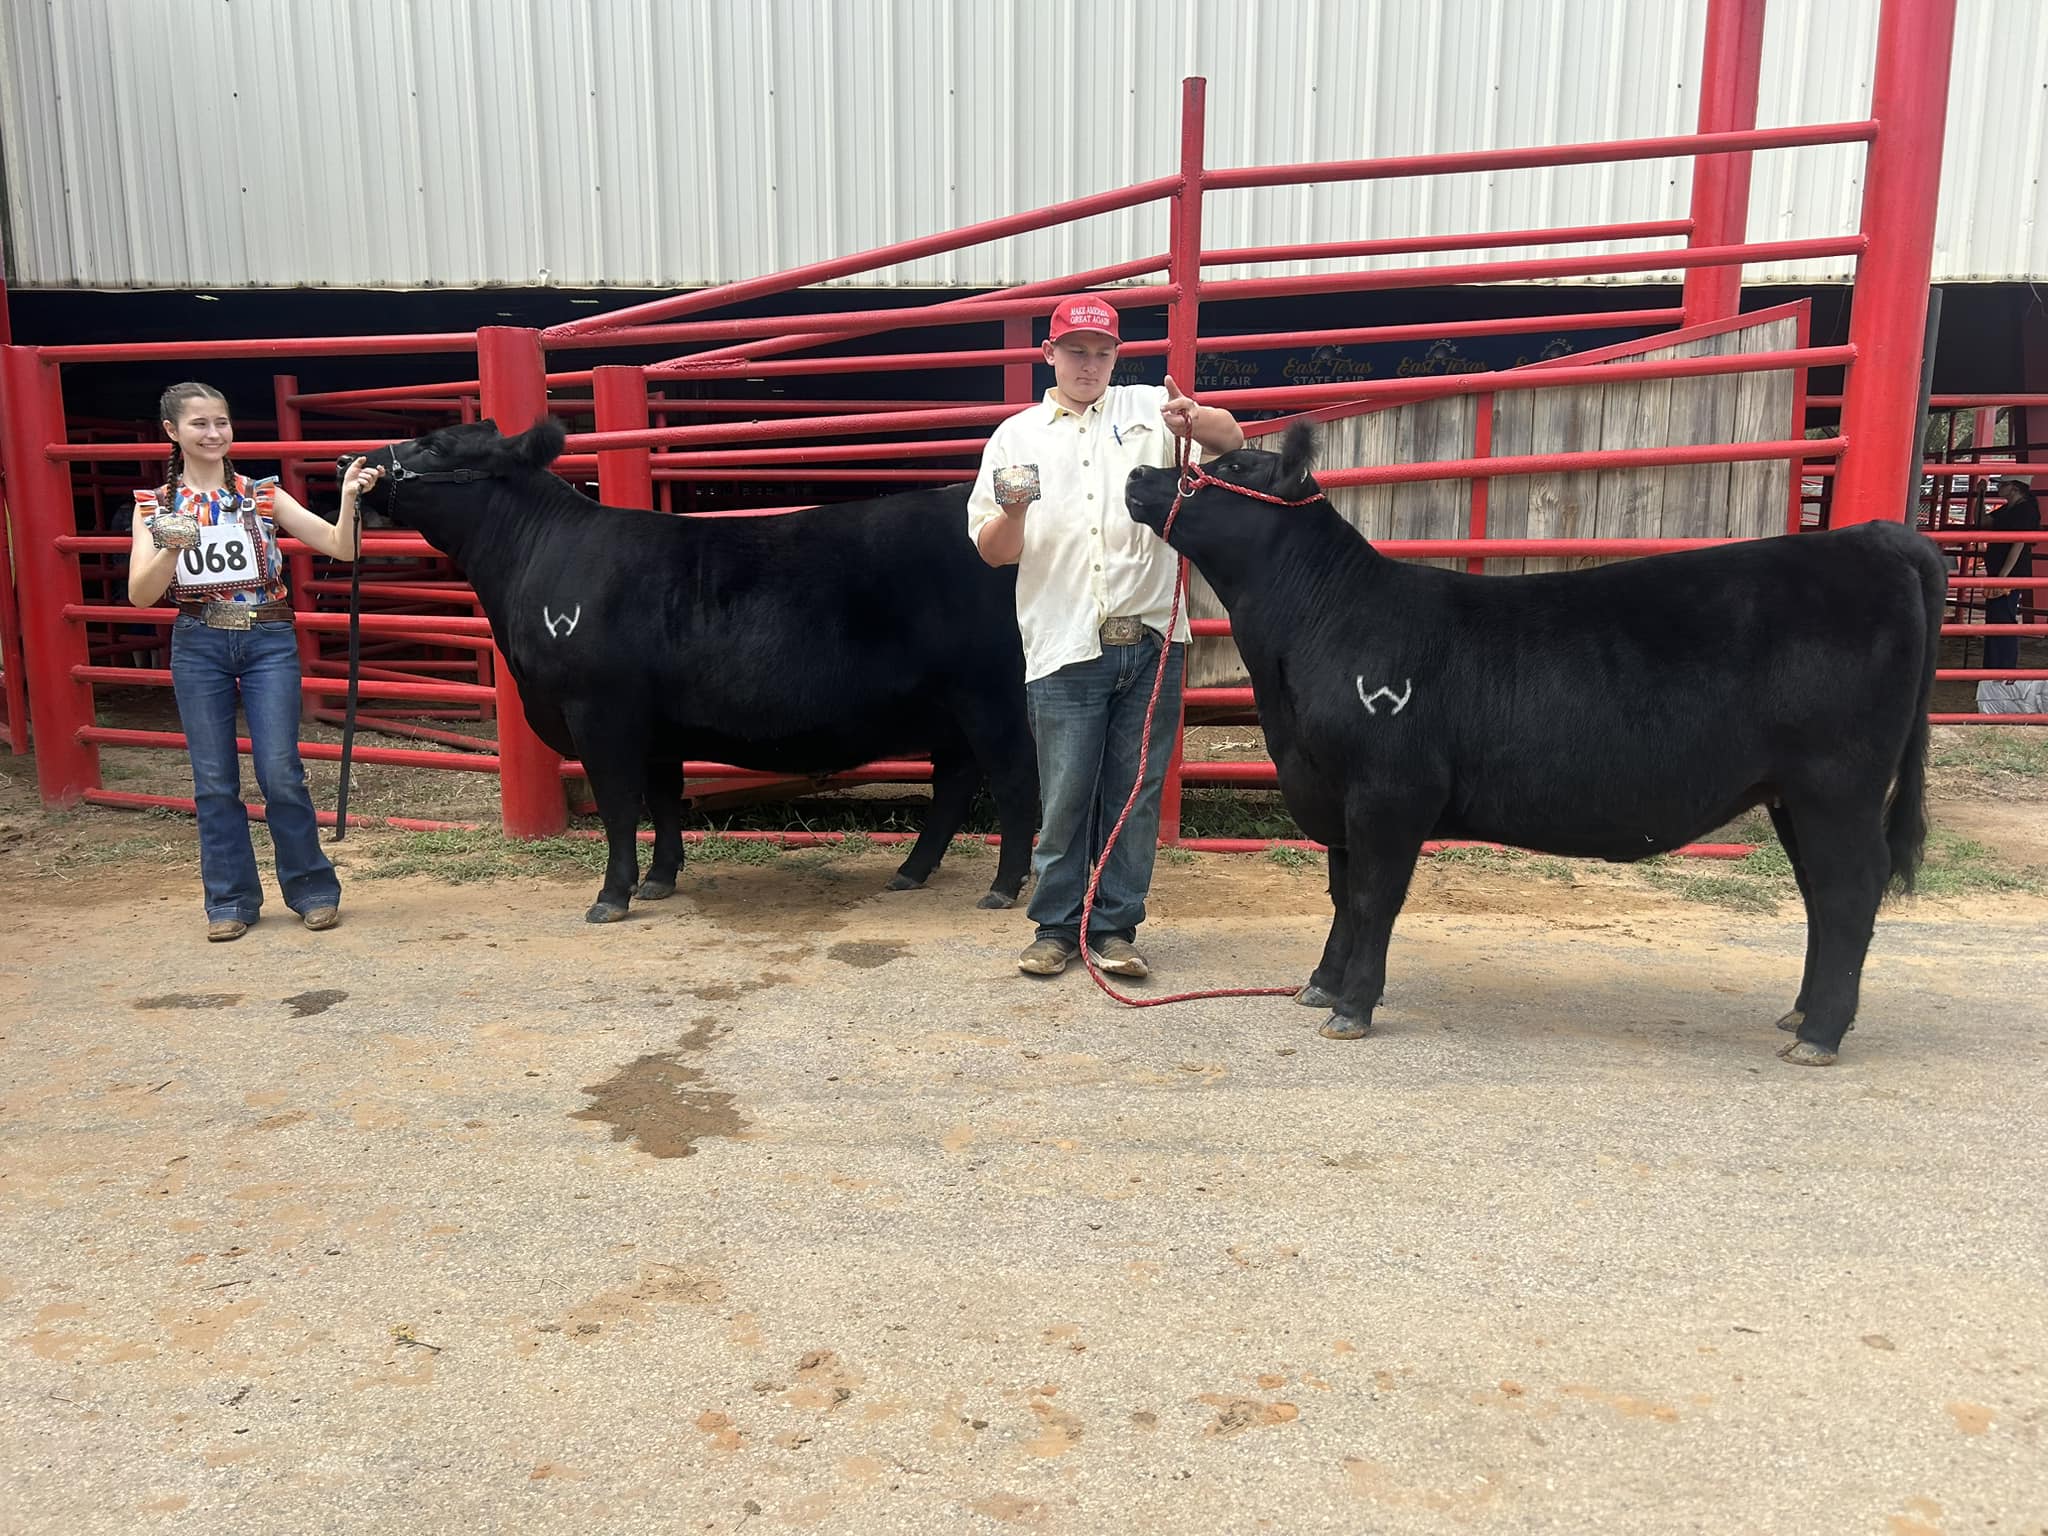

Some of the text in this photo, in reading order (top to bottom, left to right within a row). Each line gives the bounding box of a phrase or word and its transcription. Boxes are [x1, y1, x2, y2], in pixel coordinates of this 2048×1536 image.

[1071, 306, 1086, 315] MAKE
[1071, 315, 1110, 326] GREAT AGAIN
[1215, 358, 1260, 376] Texas
[1283, 358, 1374, 378] East Texas
[1397, 357, 1488, 376] East Texas
[1196, 376, 1252, 385] ATE FAIR
[183, 540, 248, 576] 068
